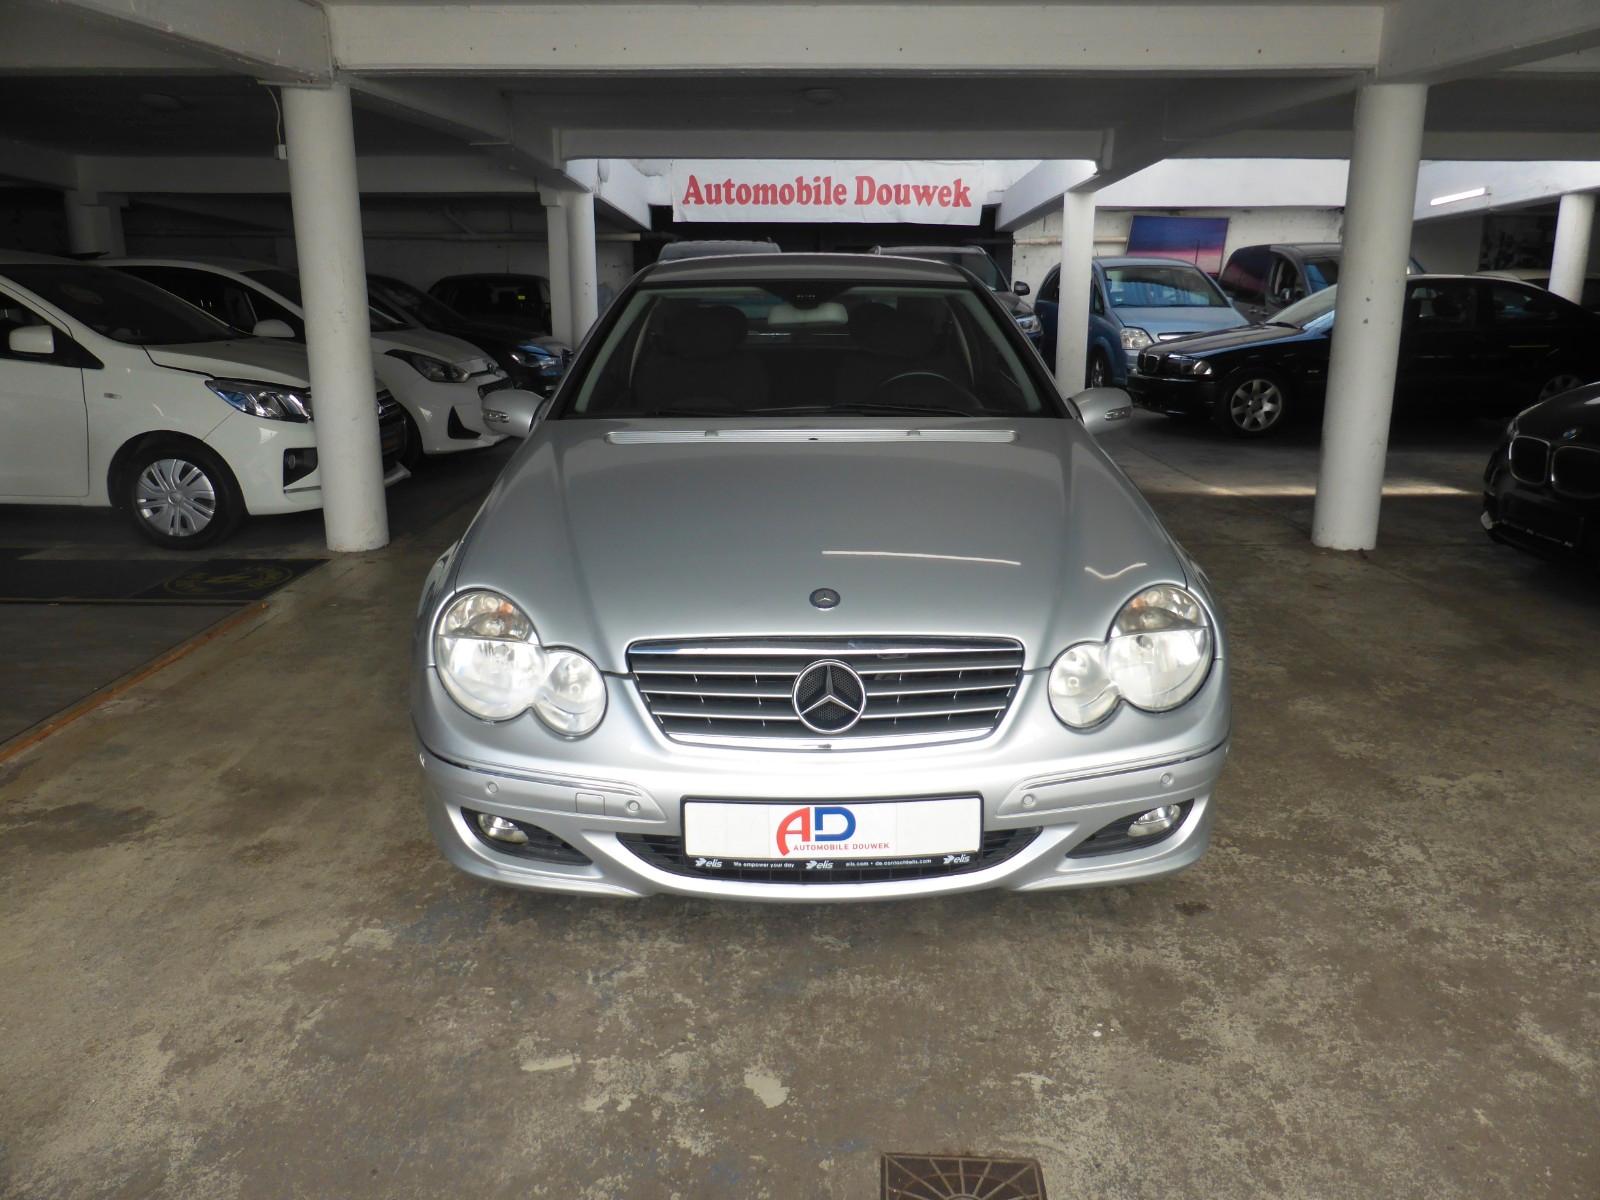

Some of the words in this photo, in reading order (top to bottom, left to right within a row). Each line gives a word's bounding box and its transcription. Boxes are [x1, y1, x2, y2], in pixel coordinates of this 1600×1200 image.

[682, 174, 847, 206] Automobile
[854, 175, 972, 208] Douwek
[793, 843, 849, 851] AUTOMOBILE
[852, 842, 890, 850] DOUWEK
[705, 858, 723, 868] elis
[953, 854, 971, 863] elis
[816, 860, 834, 869] elis
